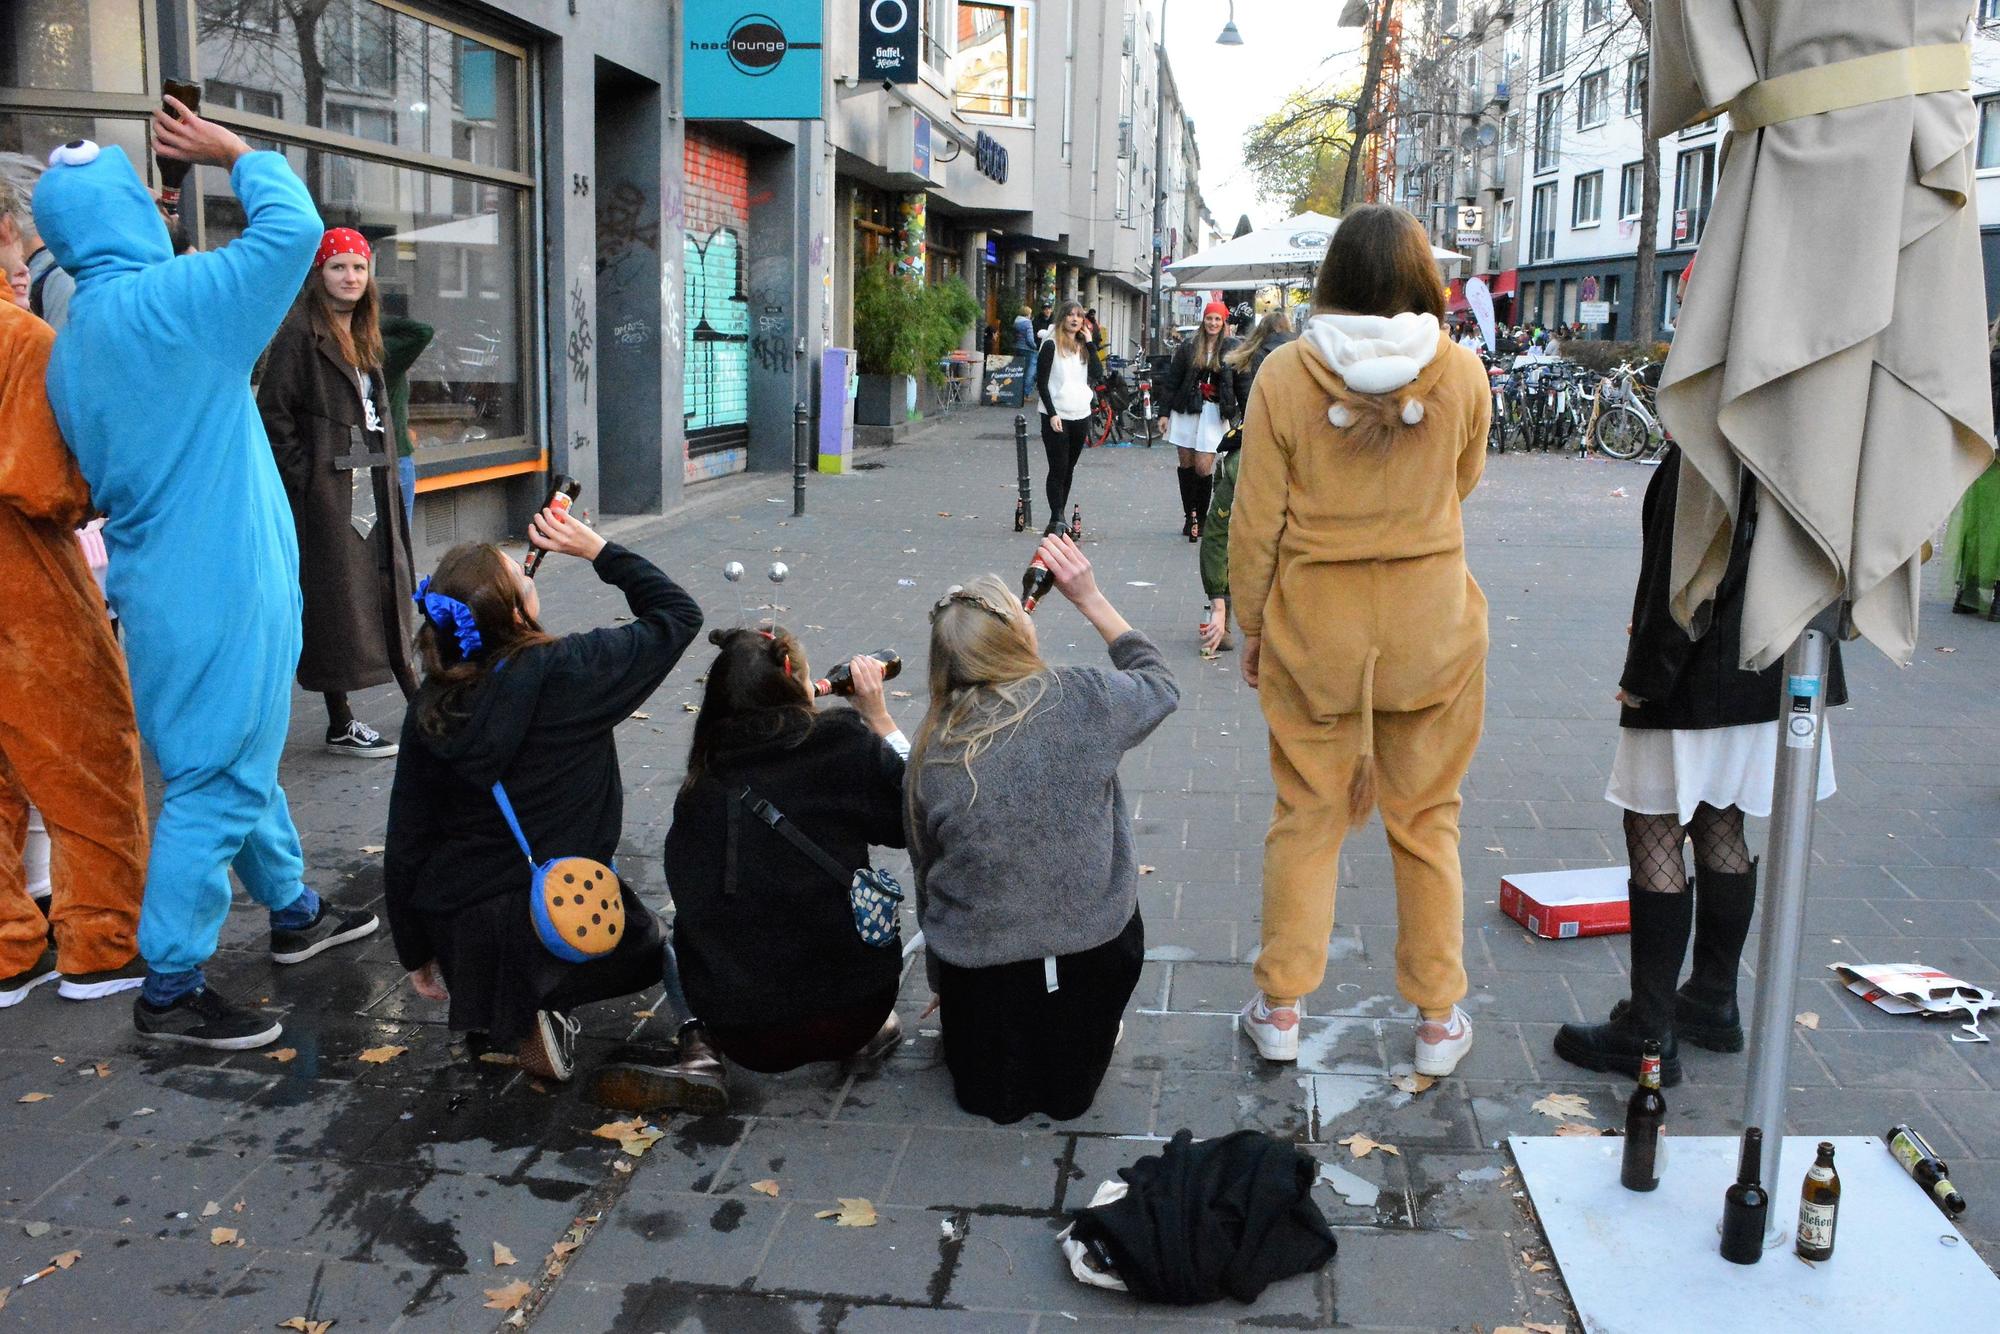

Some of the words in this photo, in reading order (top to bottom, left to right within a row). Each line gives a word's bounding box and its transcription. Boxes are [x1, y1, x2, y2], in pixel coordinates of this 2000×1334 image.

[690, 40, 729, 50] head
[732, 39, 785, 51] lounge
[876, 47, 900, 58] Gaffel
